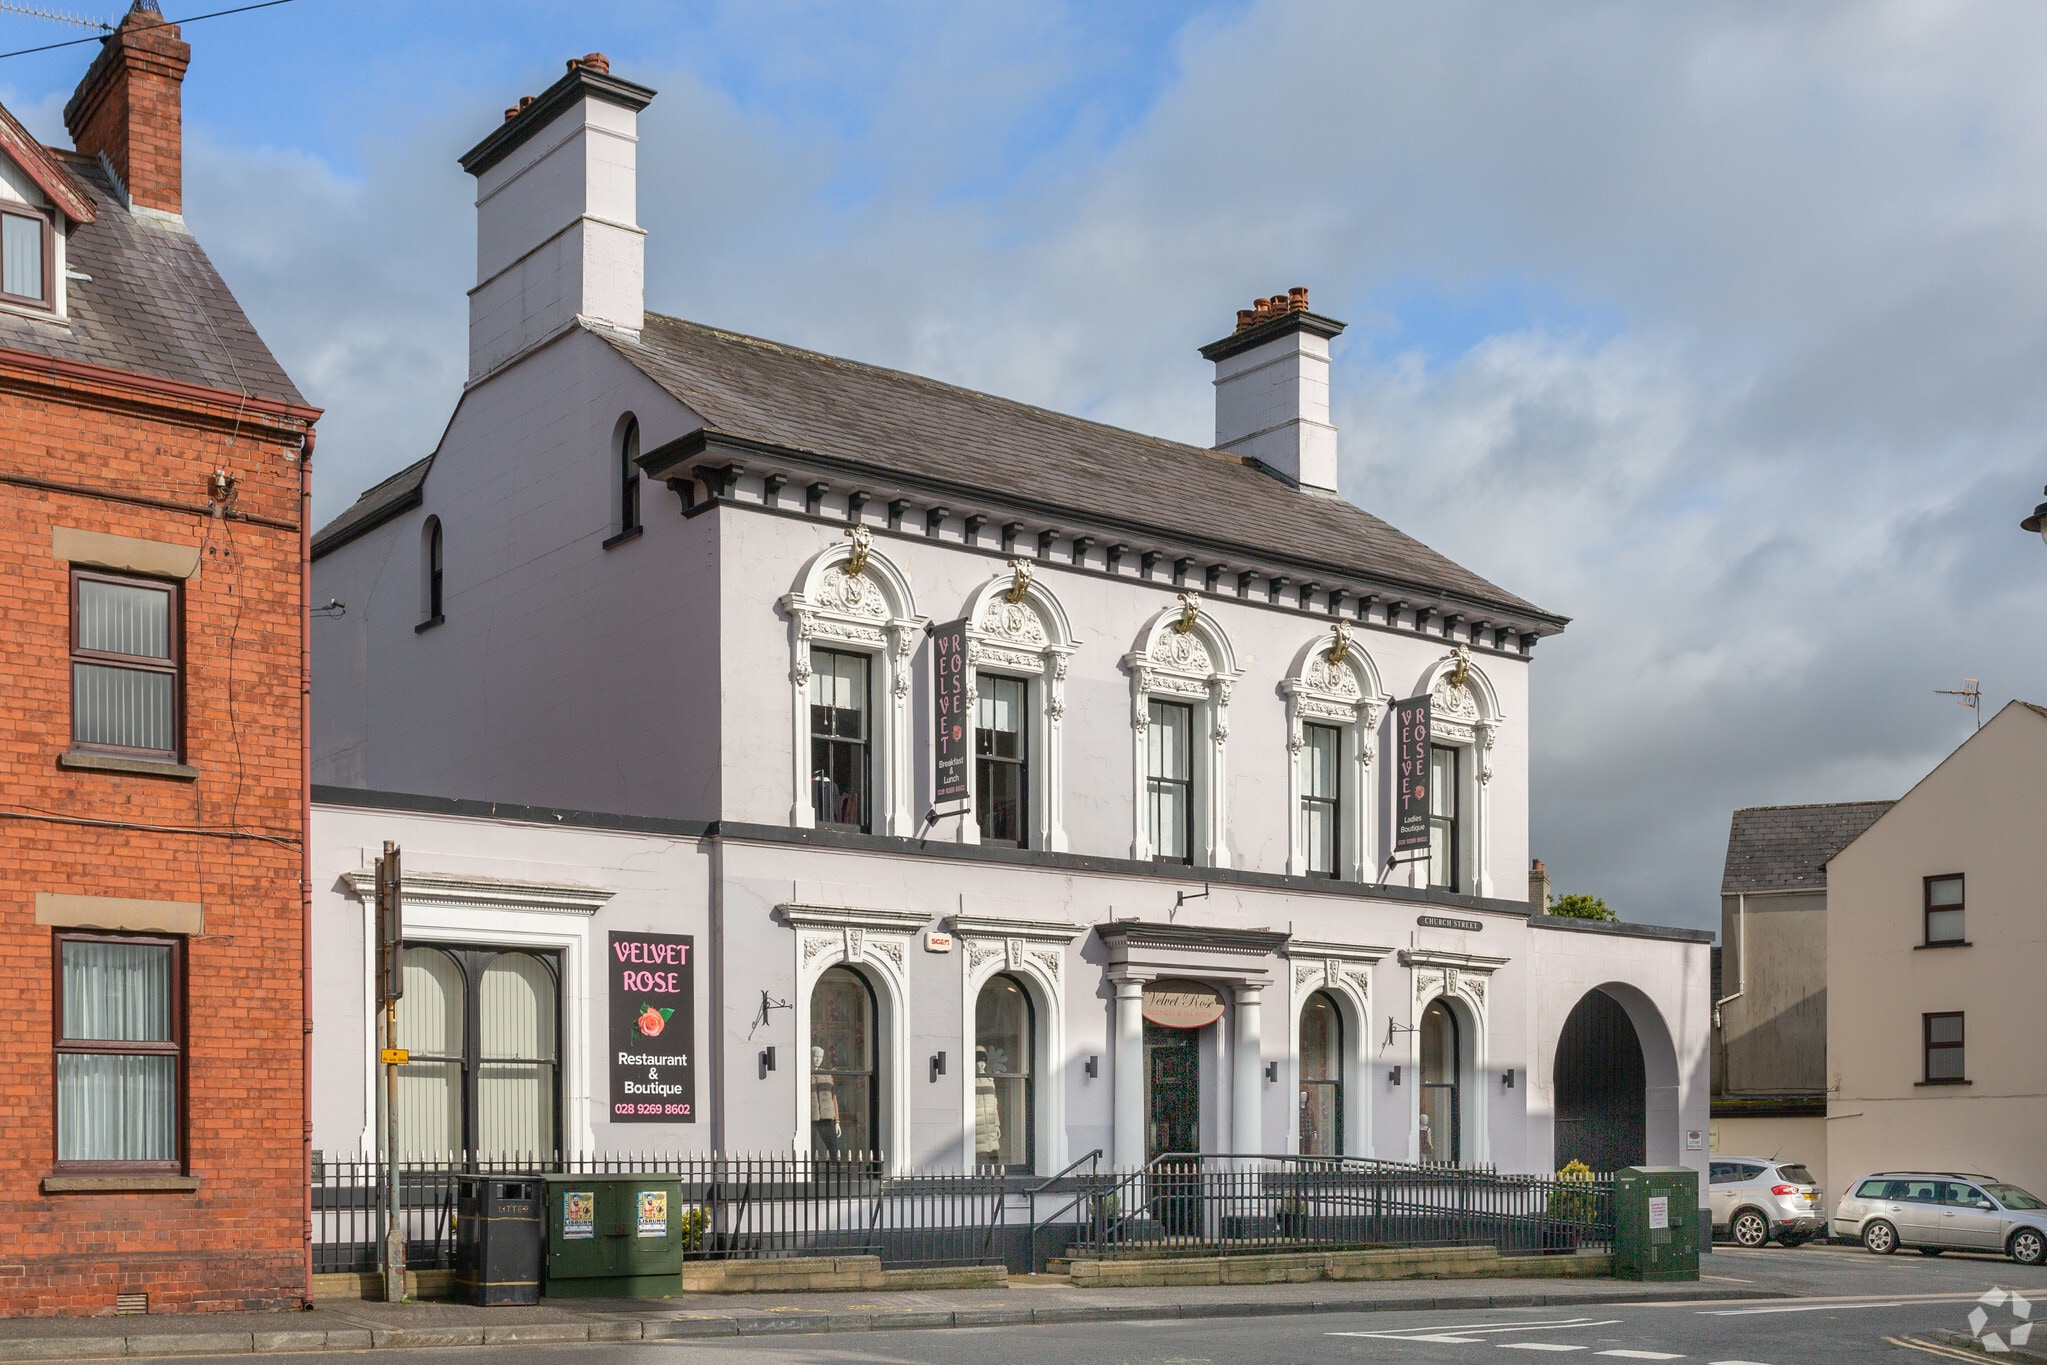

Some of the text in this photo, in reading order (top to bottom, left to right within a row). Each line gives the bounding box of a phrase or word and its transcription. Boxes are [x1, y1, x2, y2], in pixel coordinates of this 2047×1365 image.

[951, 634, 963, 714] ROSE
[938, 636, 950, 754] VELVET
[1414, 708, 1427, 775] ROSE
[938, 757, 964, 768] Breakfast
[1401, 710, 1412, 810] VELVET
[943, 774, 960, 784] Lunch
[1404, 815, 1422, 823] Ladies
[1401, 824, 1425, 833] Boutique
[1424, 917, 1478, 929] CHURCH STREET
[613, 941, 690, 965] VELVET
[623, 970, 681, 993] ROSE
[1142, 990, 1214, 1008] Velvet Rose
[618, 1051, 688, 1066] Restaurant
[648, 1067, 658, 1079] &
[624, 1080, 683, 1097] Boutique
[614, 1103, 691, 1115] 028 9269 8602
[499, 1205, 529, 1213] LITTER
